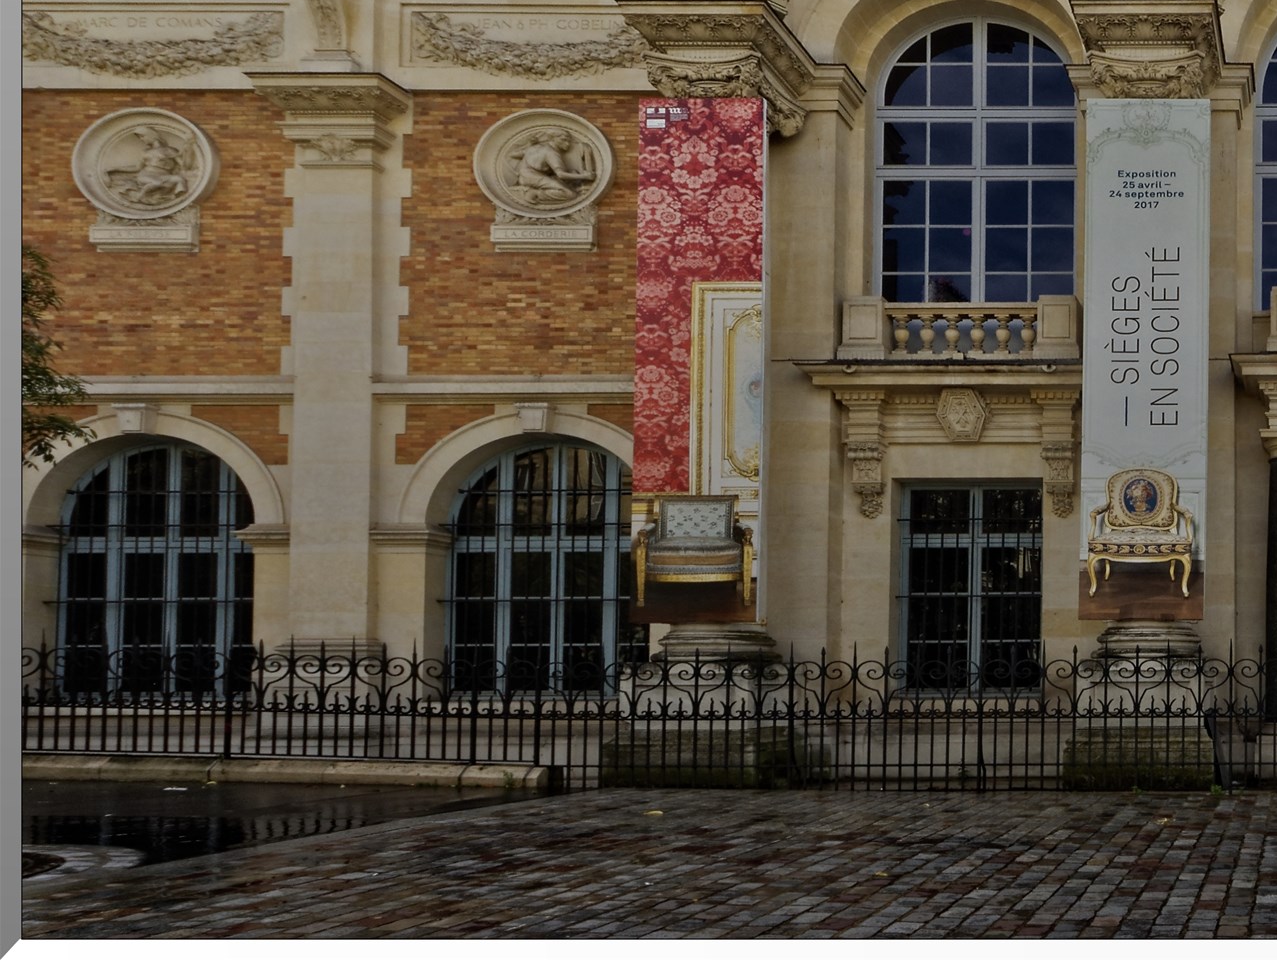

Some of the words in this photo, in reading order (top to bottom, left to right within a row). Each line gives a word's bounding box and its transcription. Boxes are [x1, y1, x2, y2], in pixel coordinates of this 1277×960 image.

[127, 16, 147, 28] DE
[1117, 170, 1176, 179] Exposition
[1122, 181, 1135, 189] 25
[1137, 181, 1162, 189] avril
[1109, 190, 1122, 198] 24
[1124, 190, 1184, 199] septembre
[1134, 201, 1159, 209] 2017
[521, 230, 578, 238] CORDERIE
[1144, 246, 1181, 376] SOCIÉTÉ
[1103, 275, 1142, 385] SIÈGES
[1149, 387, 1180, 426] EN
